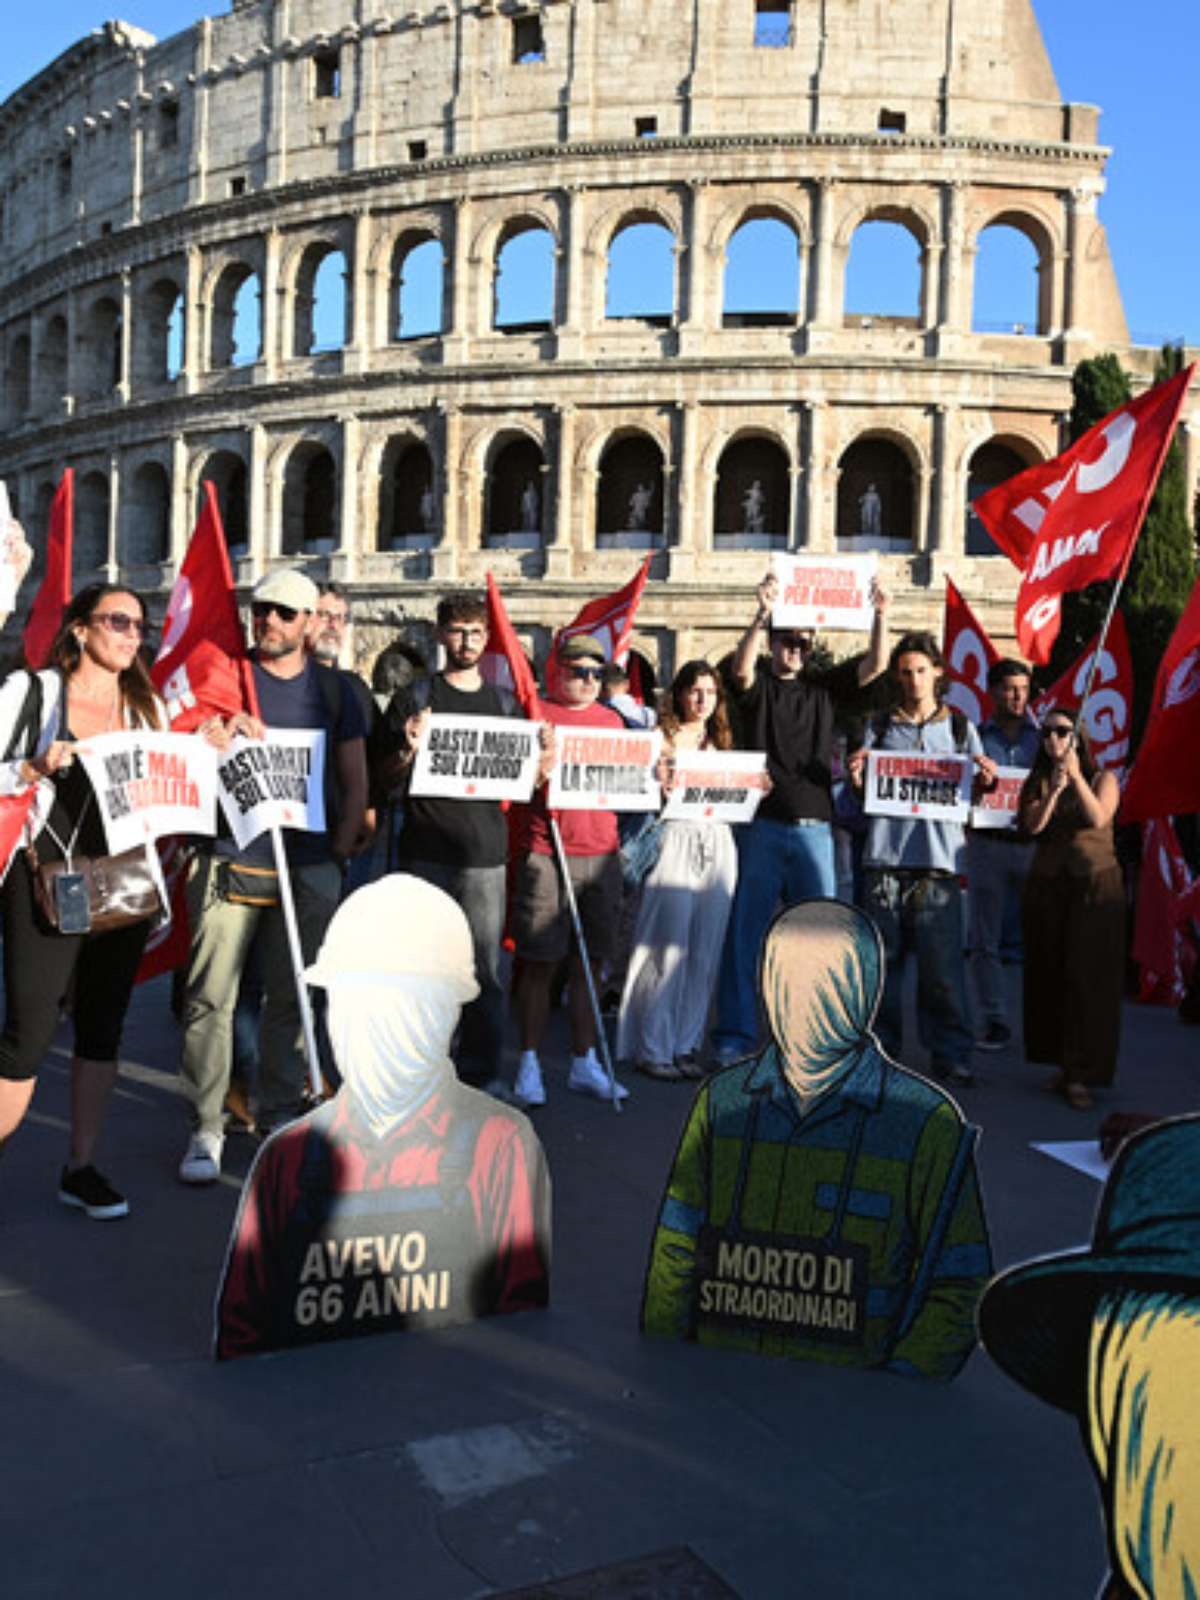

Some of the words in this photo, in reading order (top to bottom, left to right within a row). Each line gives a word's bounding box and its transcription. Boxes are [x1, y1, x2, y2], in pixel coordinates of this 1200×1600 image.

[133, 743, 143, 779] È
[148, 751, 187, 782] MAI
[427, 728, 478, 755] BASTA
[481, 730, 531, 758] MORTI
[218, 747, 270, 794] BASTA
[430, 752, 460, 776] SUL
[461, 755, 522, 780] LAVORO
[561, 763, 580, 791] LA
[583, 765, 648, 795] STRAGE
[877, 774, 894, 800] LA
[899, 776, 959, 807] STRAGE
[301, 1230, 427, 1284] AVEVO
[718, 1241, 817, 1290] MORTO
[823, 1255, 854, 1295] DI
[296, 1283, 345, 1326] 66
[353, 1270, 449, 1319] ANNI
[700, 1279, 858, 1332] STRAORDINARI
